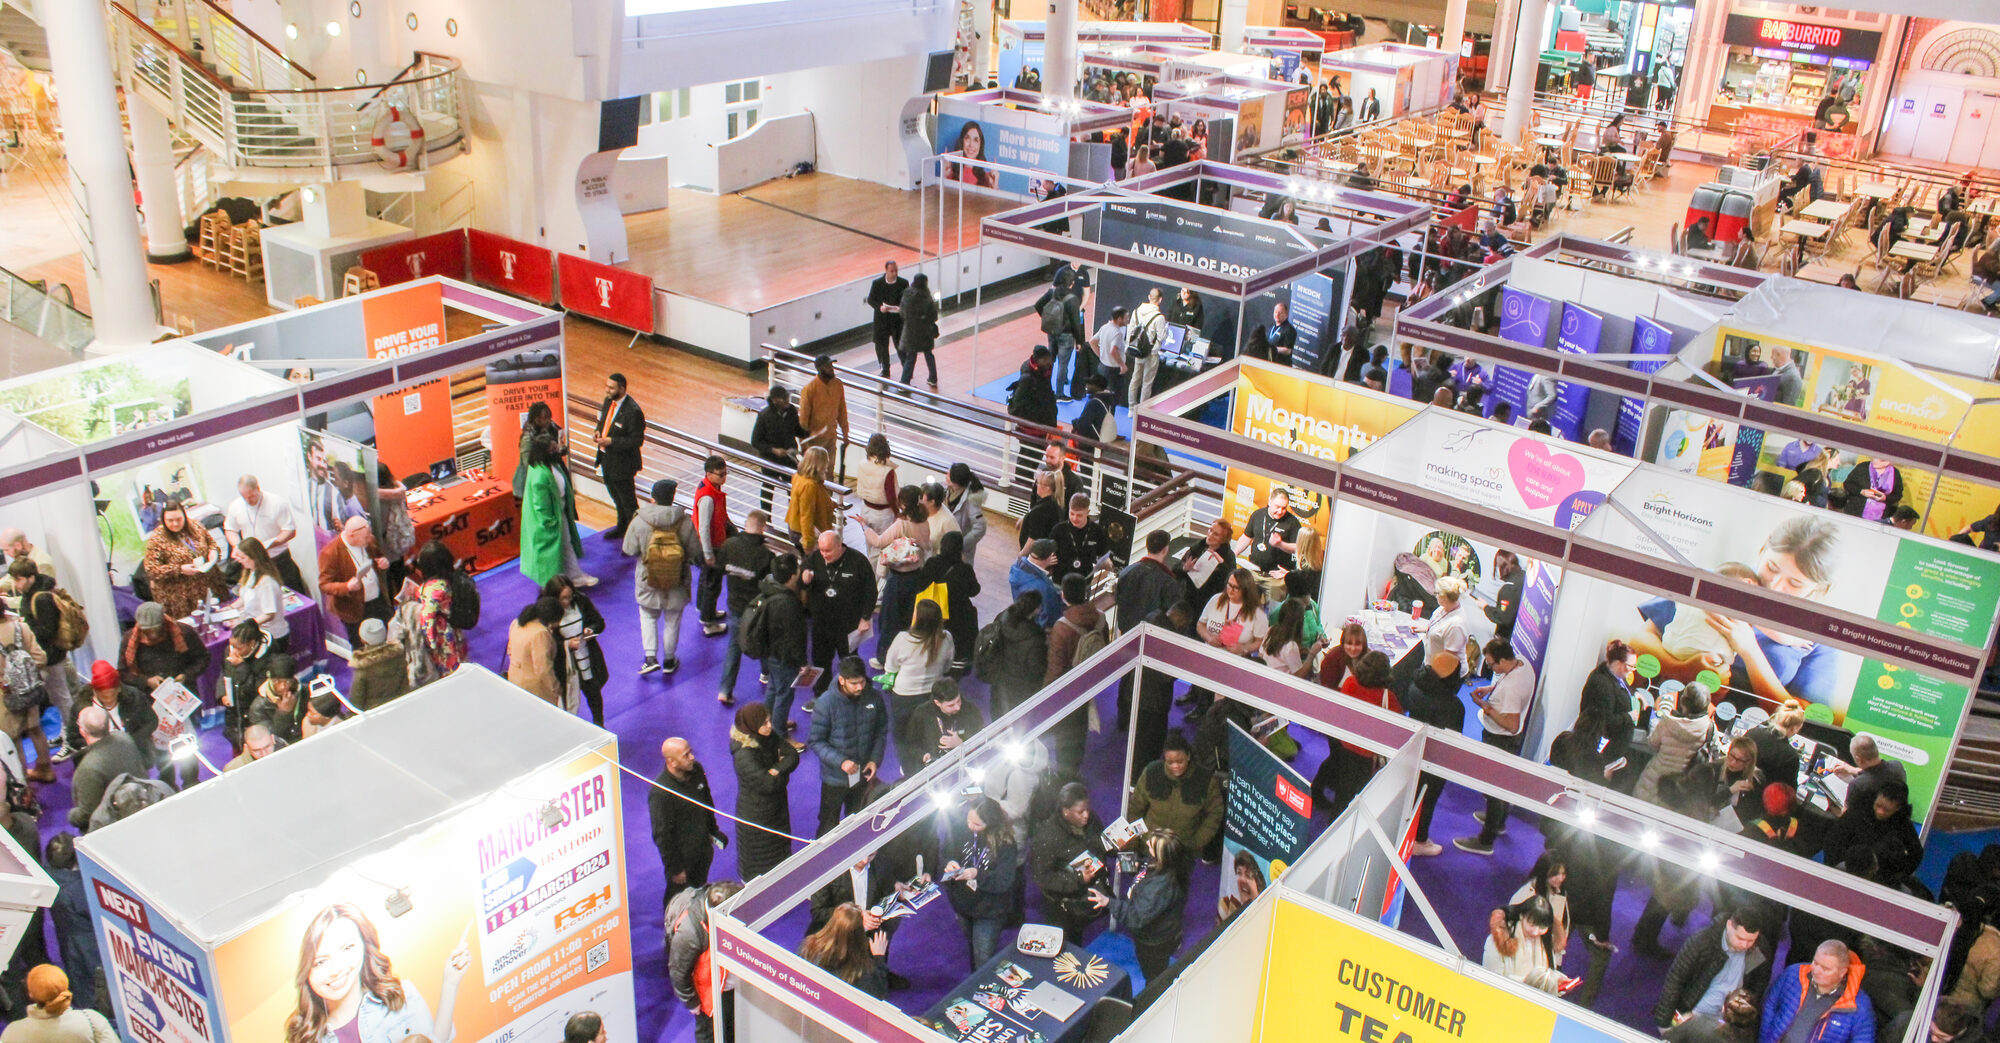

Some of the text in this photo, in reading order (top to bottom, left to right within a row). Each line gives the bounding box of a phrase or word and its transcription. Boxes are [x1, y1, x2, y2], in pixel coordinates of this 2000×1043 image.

[1760, 19, 1841, 47] BARBURRITO
[998, 144, 1040, 165] this way
[1000, 130, 1060, 153] More stands
[1256, 234, 1276, 244] molex
[1130, 242, 1140, 254] A
[1143, 245, 1193, 267] WORLD
[1198, 256, 1217, 272] OF
[374, 322, 439, 352] DRIVE YOUR
[492, 390, 560, 406] CAREER INTO THE
[504, 384, 549, 396] DRIVE YOUR
[506, 402, 524, 412] FAST
[1246, 392, 1385, 446] Momentu
[1880, 398, 1932, 419] anchor
[158, 435, 176, 446] David
[176, 430, 194, 442] Lewis
[1150, 424, 1180, 439] Momentum
[1180, 434, 1201, 444] Instore
[1876, 414, 1962, 440] anchor.org.uk/carees
[1244, 418, 1337, 463] Instore
[1426, 461, 1468, 484] making
[1470, 473, 1503, 492] space
[1552, 463, 1572, 478] about
[1106, 487, 1122, 498] Please
[1112, 482, 1124, 491] This
[1355, 483, 1378, 497] Making
[1378, 490, 1398, 502] Space
[1524, 486, 1550, 502] support
[1526, 476, 1553, 494] care and
[1572, 497, 1592, 515] APPLY
[1643, 501, 1714, 528] Bright Horizons
[1672, 534, 1698, 548] career
[1944, 566, 1974, 579] advantage
[1948, 562, 1969, 572] forward
[1828, 624, 1970, 670] 32 Bright Horizons Family Solutions
[1885, 699, 1904, 710] coming
[1924, 711, 1939, 720] every
[1877, 739, 1893, 748] Apply
[1236, 776, 1251, 792] can
[1252, 784, 1282, 818] honestly
[1282, 813, 1296, 830] say
[478, 774, 606, 874] MANCHSTER
[1228, 792, 1291, 854] I've ever worked
[1234, 813, 1246, 828] my
[1243, 792, 1298, 846] the best place
[100, 885, 143, 924] NEXT
[489, 853, 607, 930] 1 & 2 MARCH 2024
[554, 884, 612, 930] FGH
[554, 900, 610, 936] SECURITY
[132, 926, 198, 985] EVENT
[489, 976, 519, 1003] OPEN
[521, 956, 552, 984] FROM
[554, 938, 582, 963] 11:00
[592, 915, 620, 940] 17:00
[492, 948, 528, 975] hanover
[494, 942, 524, 967] anchor
[526, 983, 540, 996] THE
[550, 964, 568, 981] CODE
[568, 955, 582, 969] FOR
[722, 938, 820, 1001] 26 University of Salford
[108, 928, 210, 1042] MANCHESTER
[1338, 958, 1467, 1039] CUSTOMER
